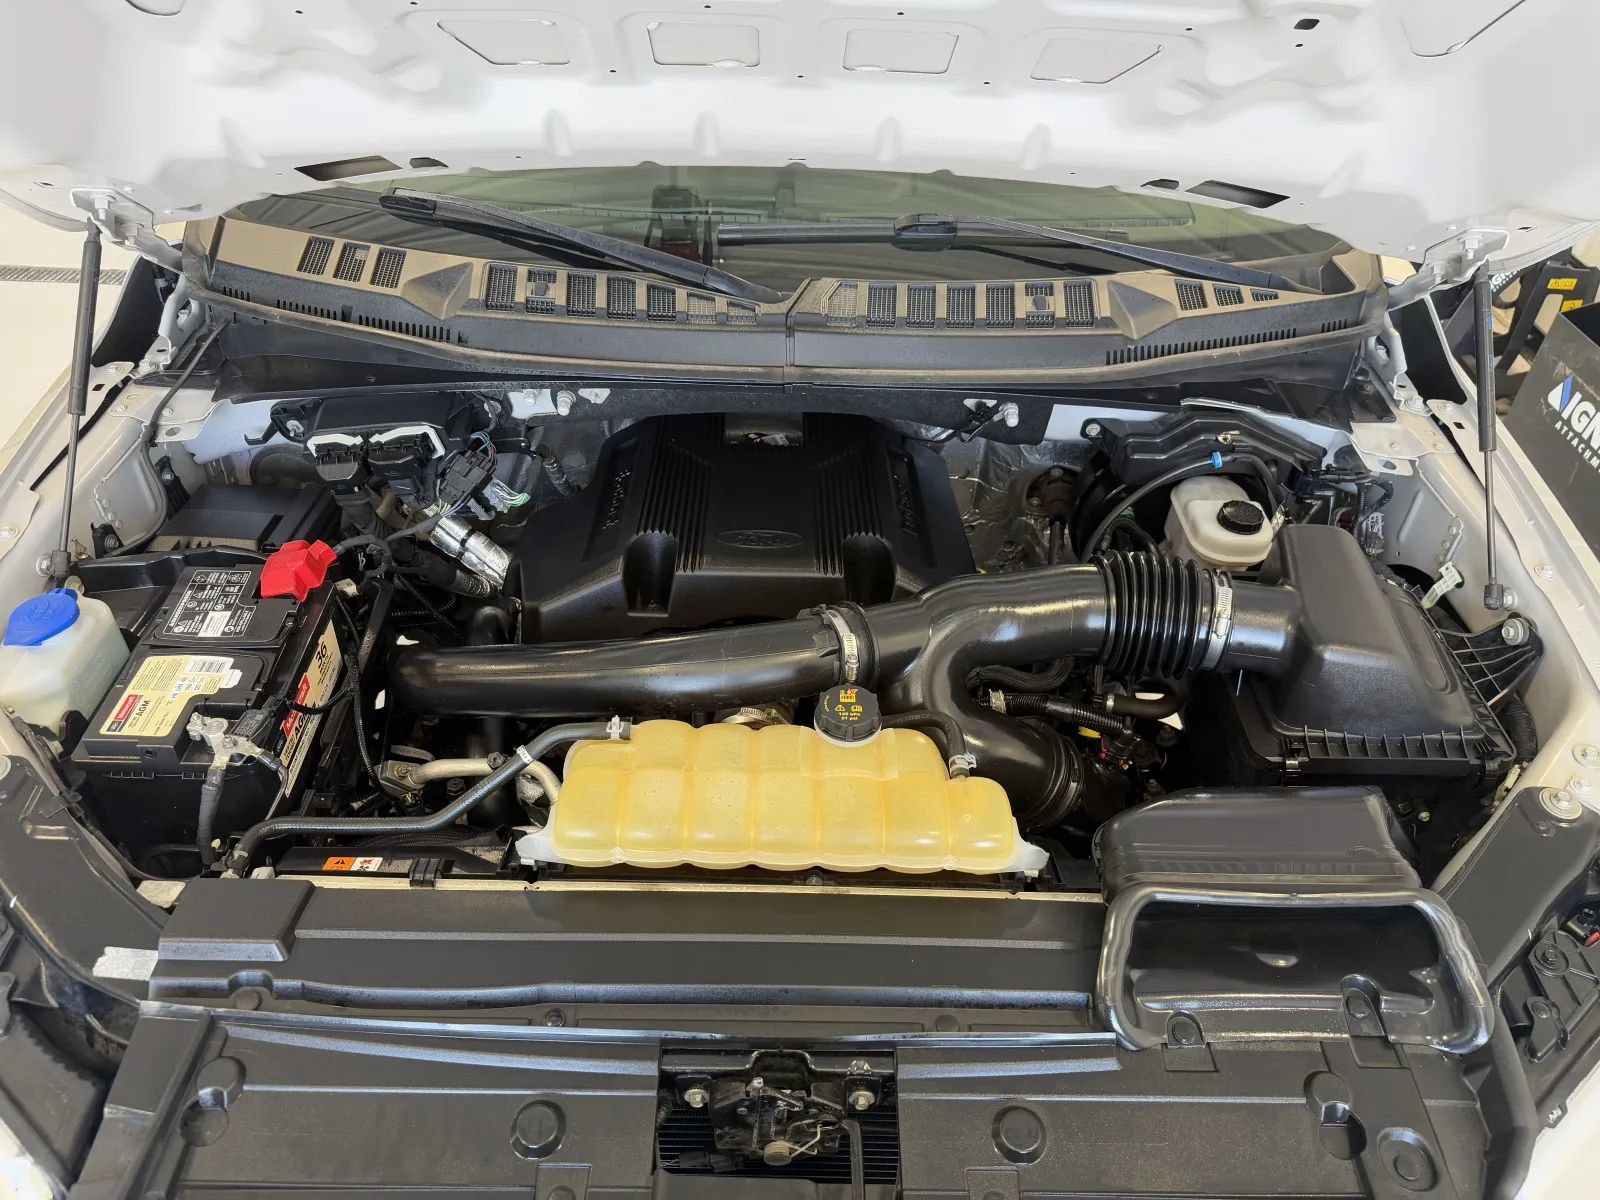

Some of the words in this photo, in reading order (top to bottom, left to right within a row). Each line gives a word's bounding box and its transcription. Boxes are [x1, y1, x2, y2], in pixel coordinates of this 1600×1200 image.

[1561, 391, 1600, 456] IGN
[1554, 420, 1600, 472] ATTACHM
[315, 641, 327, 669] 36
[136, 700, 151, 717] AGM
